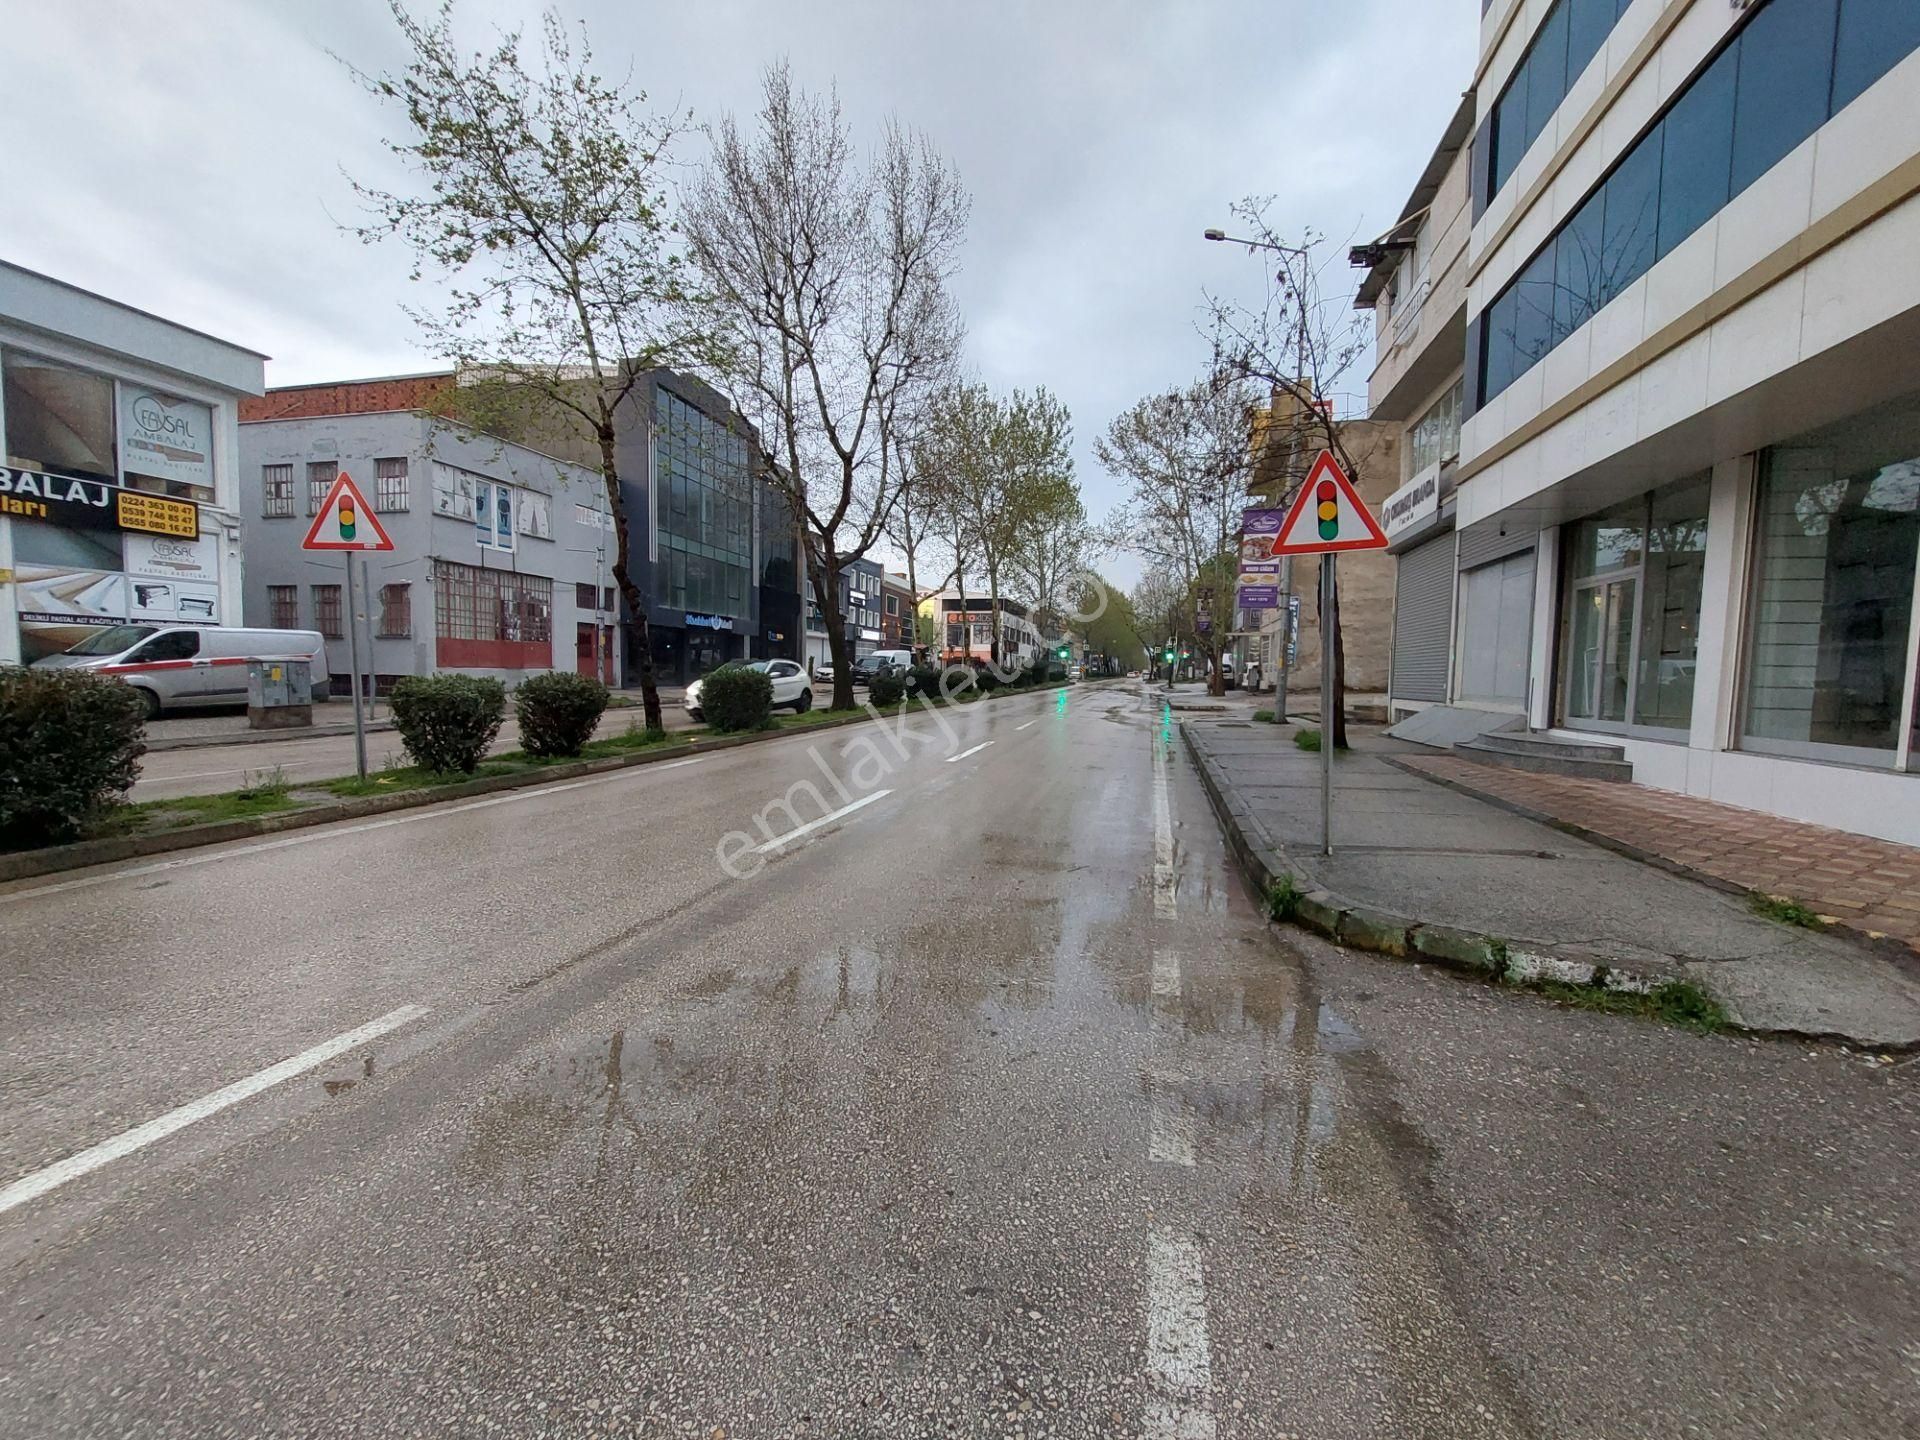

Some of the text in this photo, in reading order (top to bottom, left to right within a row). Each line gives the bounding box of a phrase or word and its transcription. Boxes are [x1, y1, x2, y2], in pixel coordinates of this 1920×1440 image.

[133, 428, 196, 450] AMBALAJ
[121, 495, 146, 508] 0224
[167, 504, 179, 513] 00
[181, 506, 193, 516] 47
[181, 516, 193, 525] 47
[181, 526, 193, 534] 47
